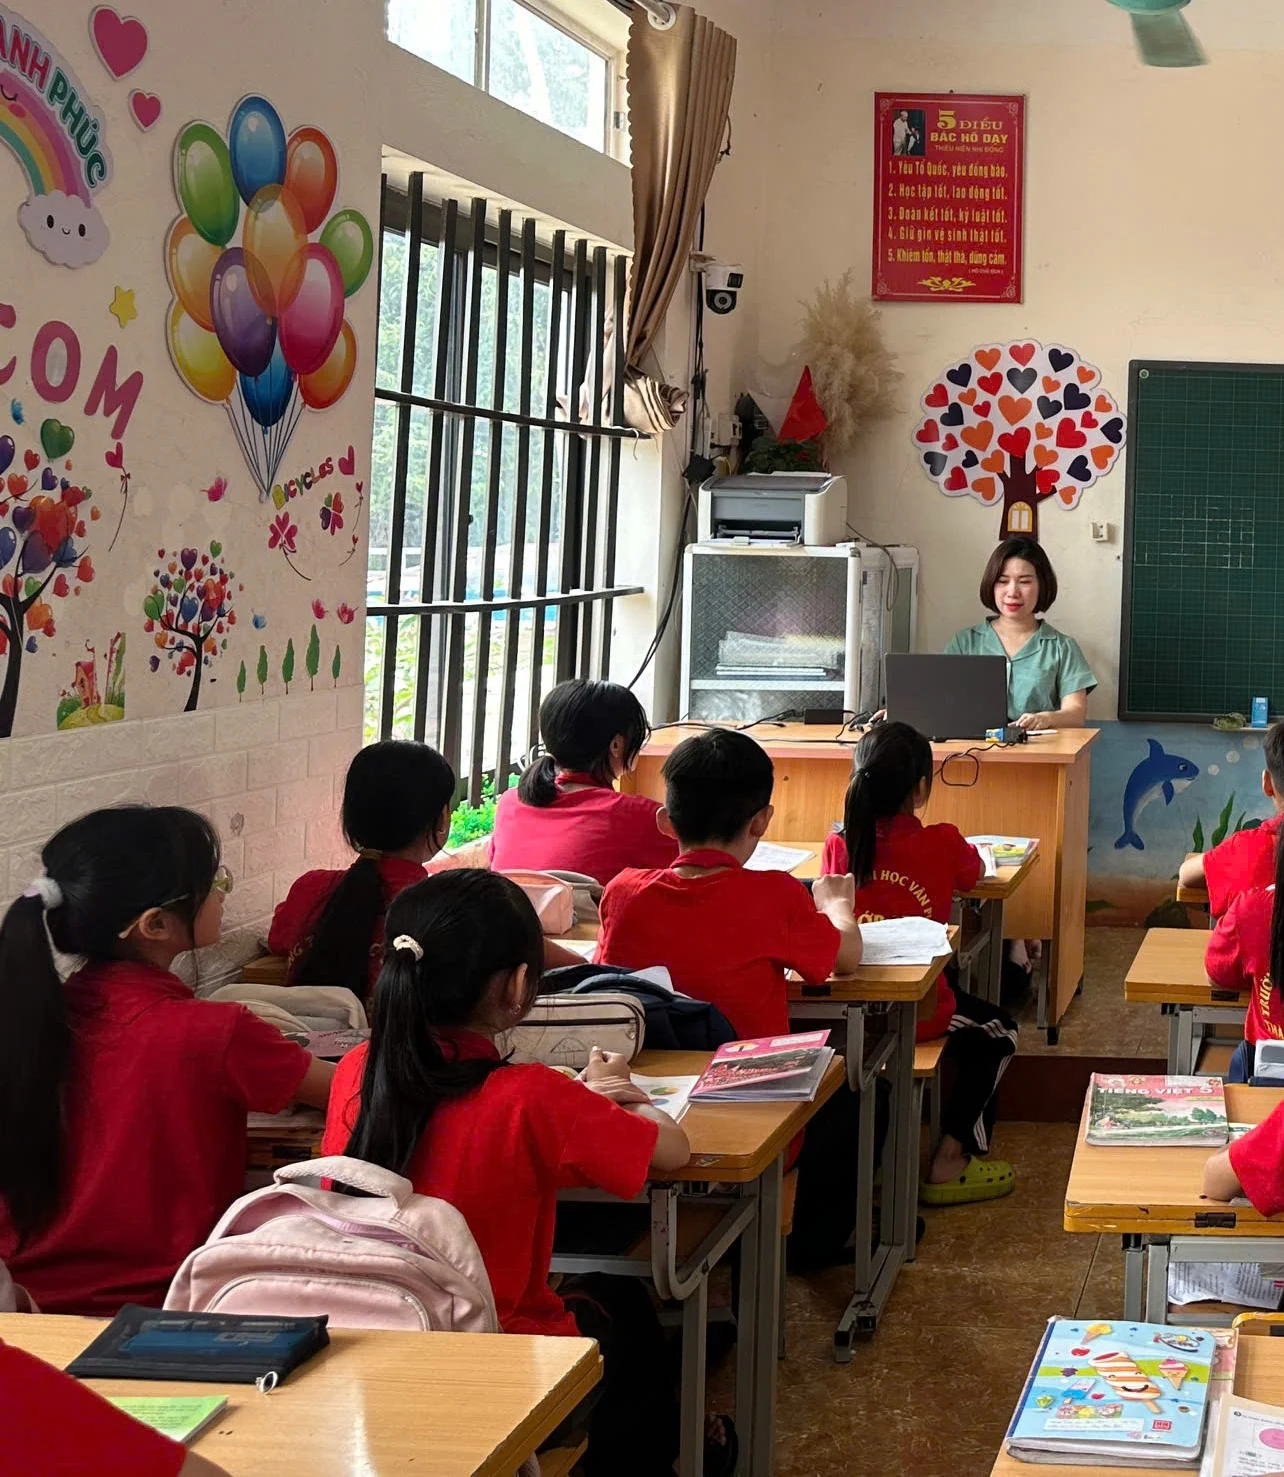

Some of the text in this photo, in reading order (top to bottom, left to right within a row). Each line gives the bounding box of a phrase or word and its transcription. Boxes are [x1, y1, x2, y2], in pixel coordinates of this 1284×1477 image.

[50, 69, 106, 188] PHÚC
[937, 109, 1004, 130] 5 ĐIỀU
[930, 131, 957, 142] BÁC
[960, 132, 978, 143] HỒ
[888, 161, 896, 175] 1.
[899, 160, 913, 175] Yêu
[915, 159, 925, 175] Tổ
[952, 162, 967, 178] yêu
[968, 161, 988, 179] đồng
[888, 183, 897, 197] 2.
[899, 183, 915, 199] Học
[918, 183, 932, 200] tập
[952, 184, 966, 199] lao
[968, 184, 990, 201] động
[992, 183, 1008, 200] tốt.
[888, 206, 897, 220] 3.
[899, 206, 921, 220] Đoàn
[923, 205, 938, 221] kết
[972, 207, 989, 225] luật
[992, 207, 1008, 223] tốt.
[888, 225, 1007, 245] 4. Giữ gìn vệ sinh thật tốt.
[887, 248, 895, 262] 5.
[896, 248, 921, 263] Khiêm
[937, 249, 952, 266] thật
[969, 250, 987, 266] dũng
[881, 870, 909, 886] HỌC
[908, 880, 931, 907] VÂN
[1260, 972, 1273, 1016] TRƯỜ
